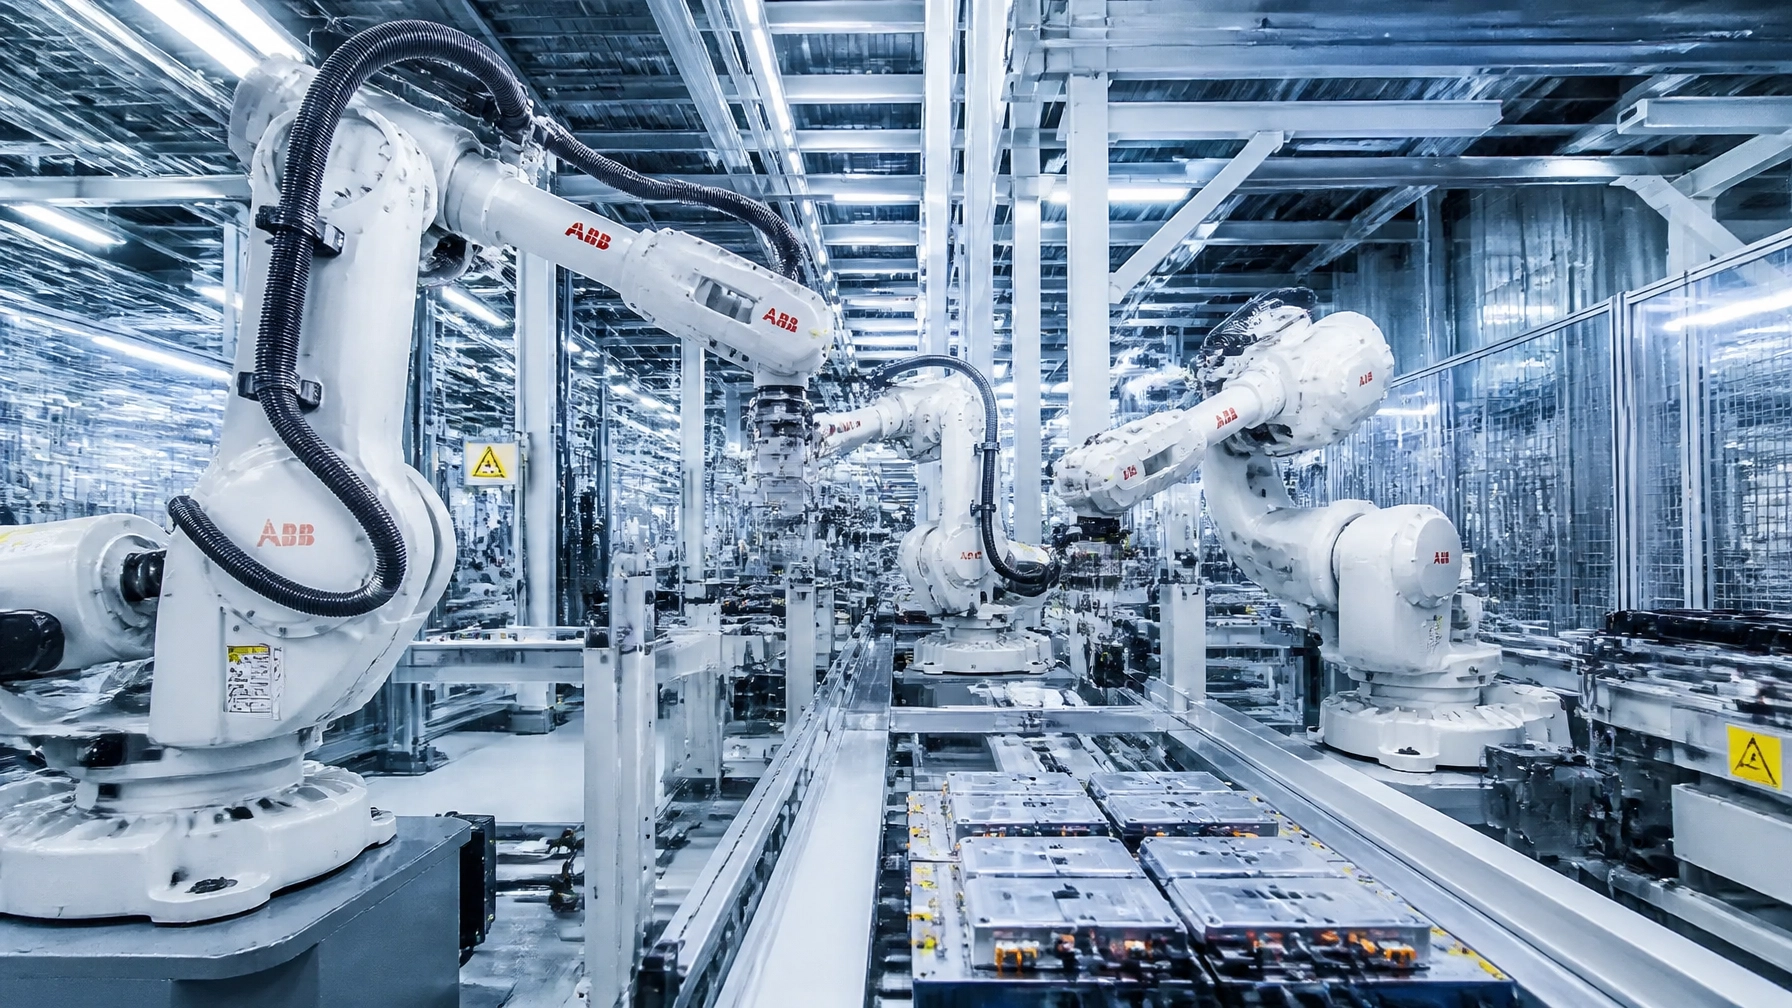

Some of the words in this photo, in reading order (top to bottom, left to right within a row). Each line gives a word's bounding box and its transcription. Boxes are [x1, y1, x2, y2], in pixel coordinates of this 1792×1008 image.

[564, 222, 612, 251] ABB
[762, 307, 799, 333] ABB
[256, 518, 315, 548] ABB
